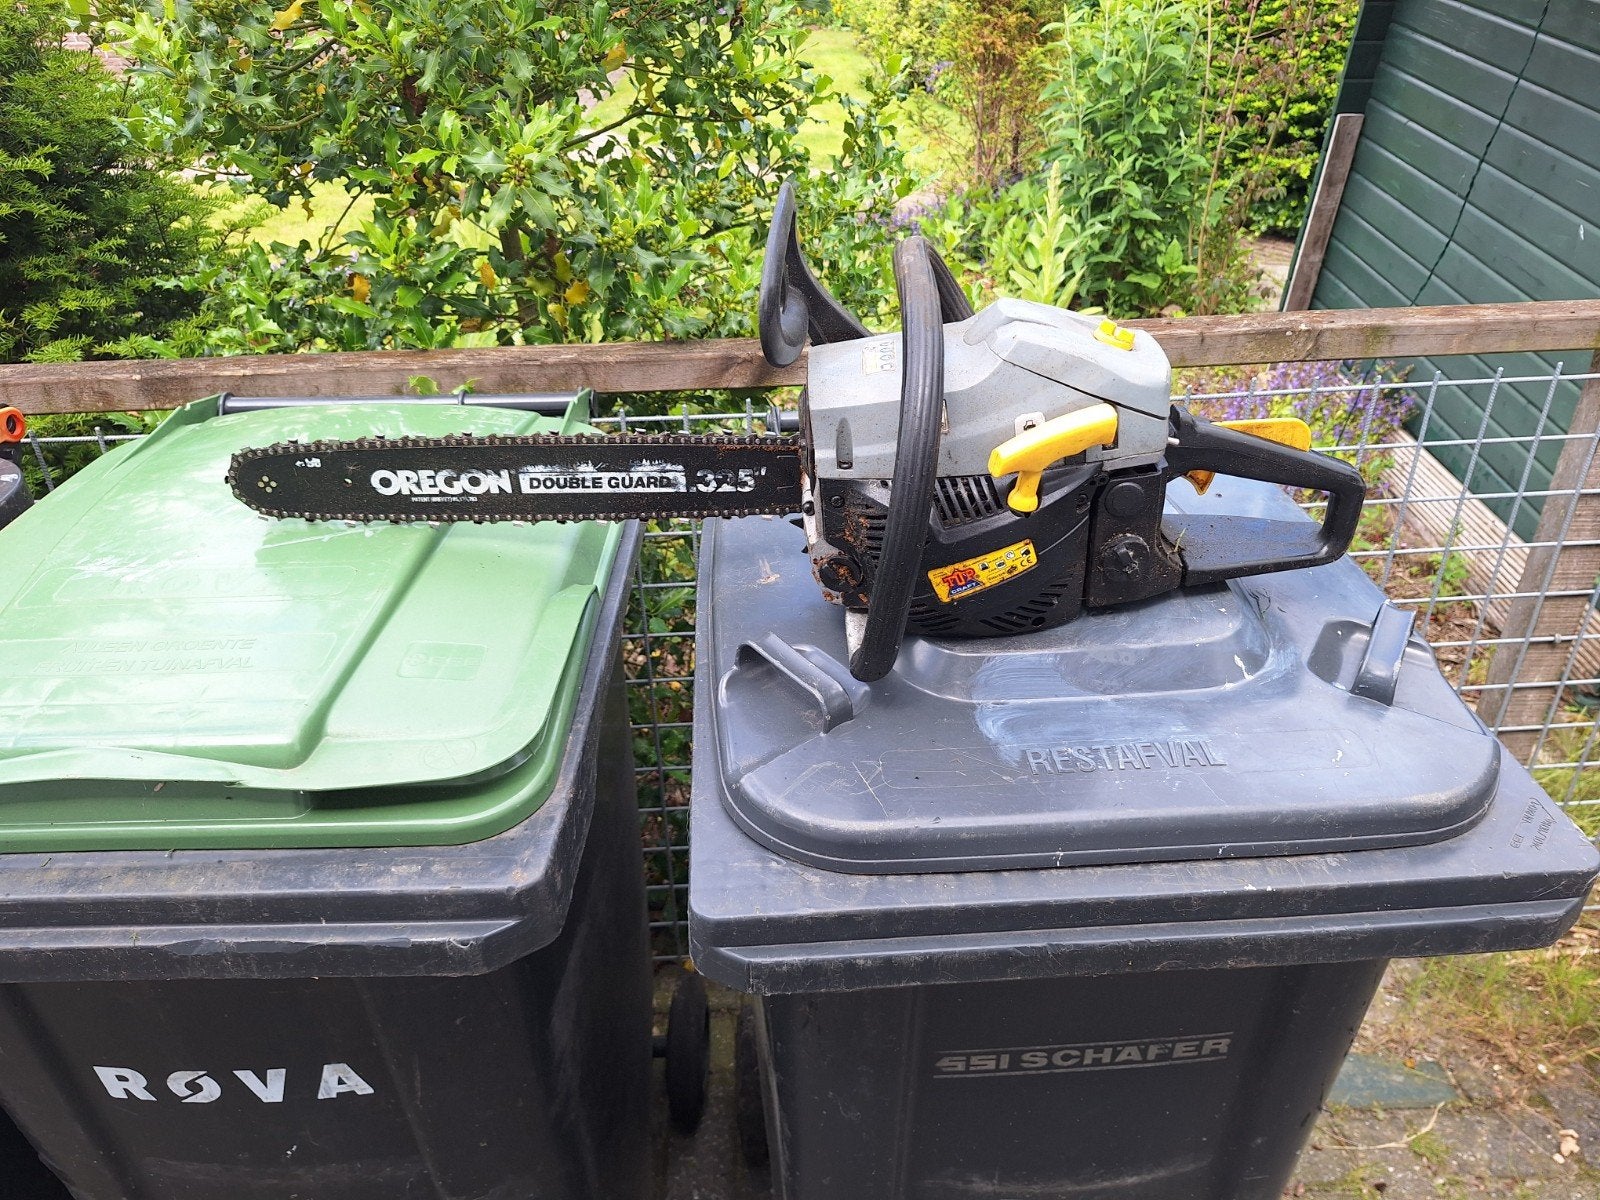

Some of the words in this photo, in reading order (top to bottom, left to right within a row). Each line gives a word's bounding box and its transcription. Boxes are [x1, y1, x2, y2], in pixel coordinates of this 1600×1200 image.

[370, 469, 513, 496] OREGON
[528, 475, 604, 490] DOUBLE
[606, 475, 672, 489] GUARD
[951, 582, 977, 595] CRAFT
[1026, 741, 1228, 775] RESTAFVAL
[934, 1053, 1011, 1073] SSI
